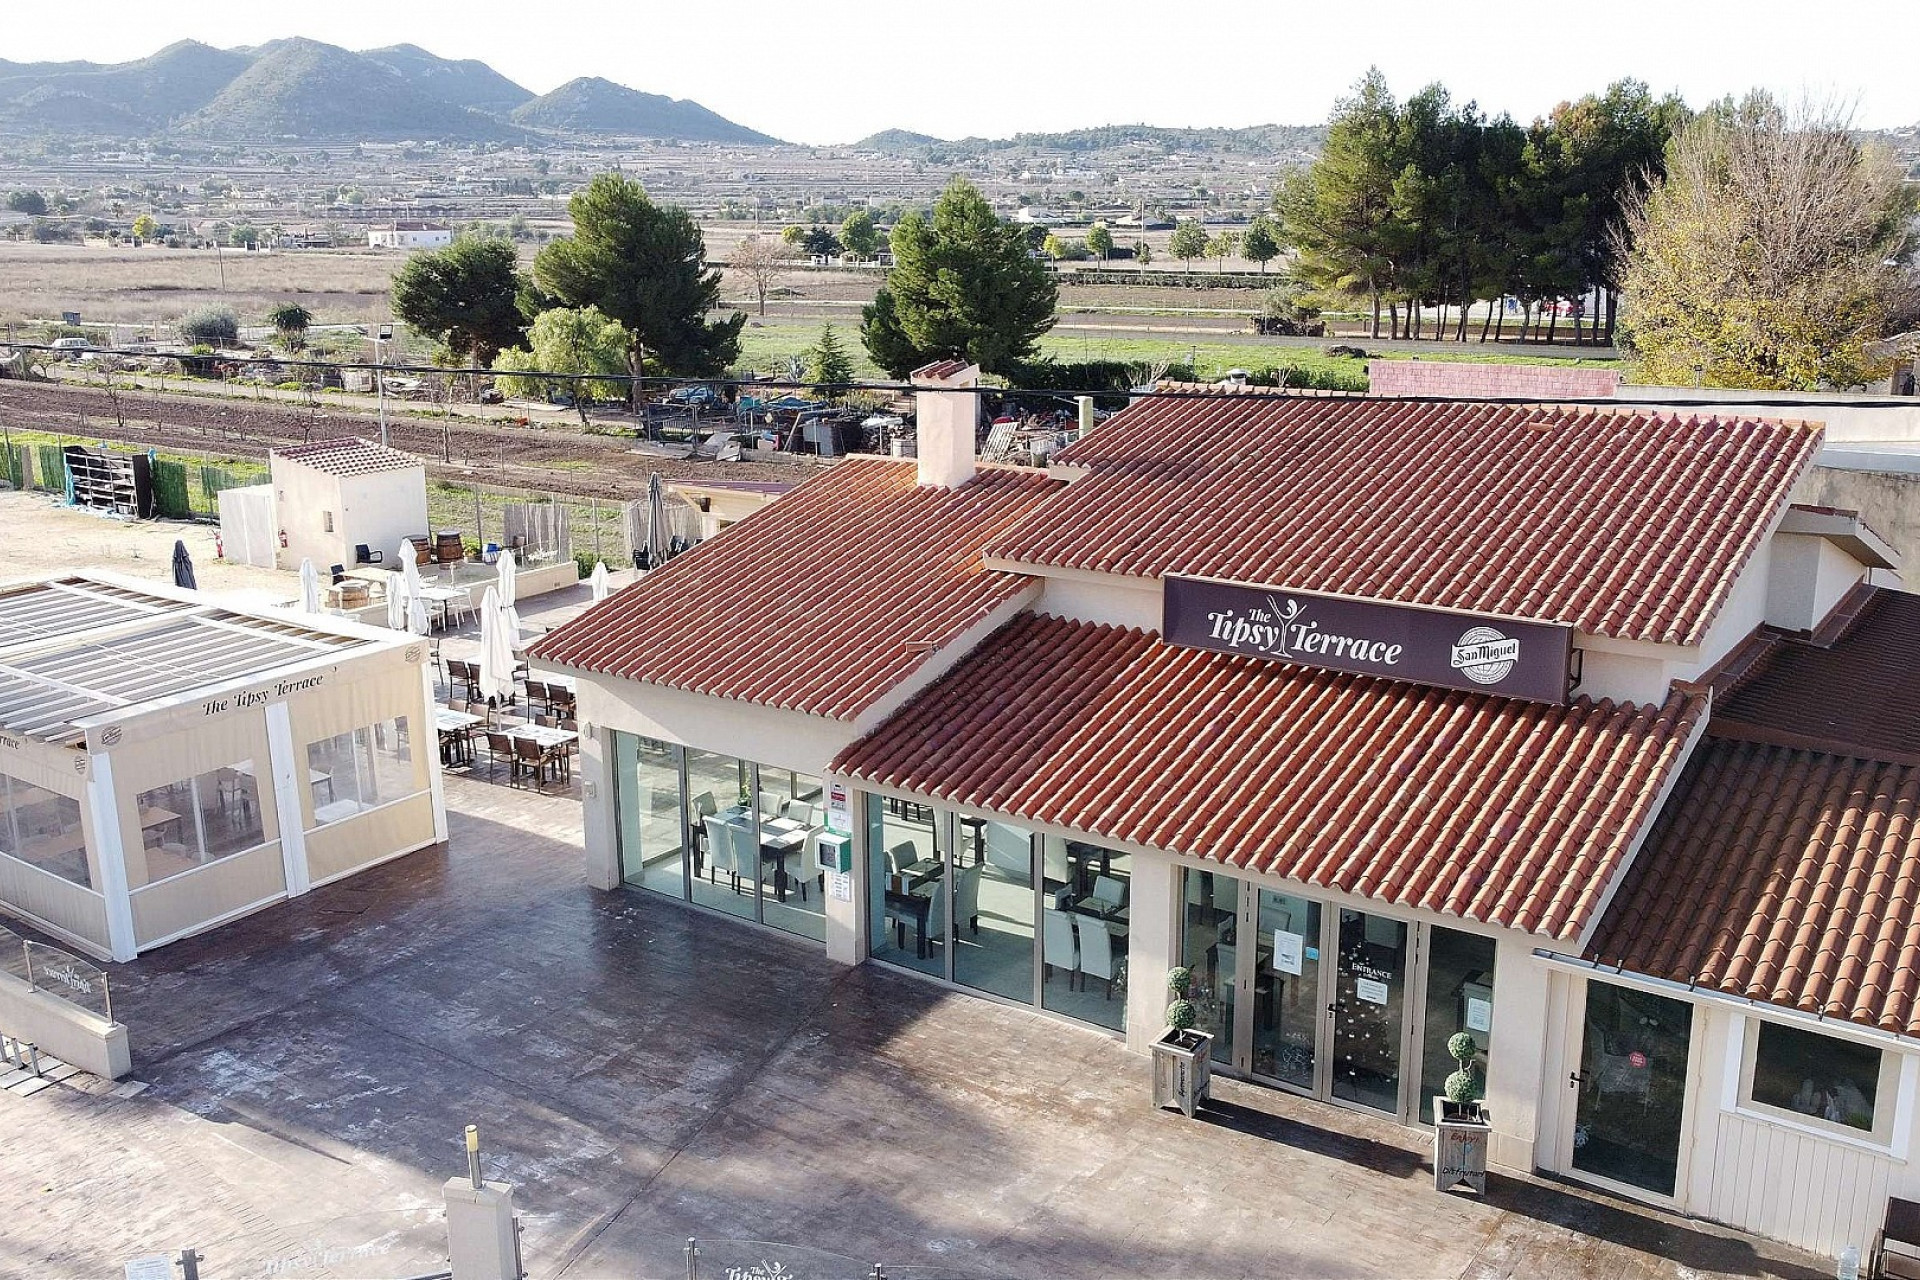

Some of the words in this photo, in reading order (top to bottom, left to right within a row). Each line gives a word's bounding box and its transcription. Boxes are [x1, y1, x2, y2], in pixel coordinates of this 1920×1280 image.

[1249, 608, 1272, 623] The
[1207, 609, 1280, 652] Tipsy
[1290, 620, 1403, 665] Terrace
[1452, 648, 1478, 666] San
[1476, 642, 1516, 660] Miguel
[202, 699, 229, 716] The
[233, 690, 269, 707] Tipsy
[273, 674, 324, 697] Terrace
[1351, 961, 1393, 980] ENTRANCE
[750, 1266, 765, 1275] The
